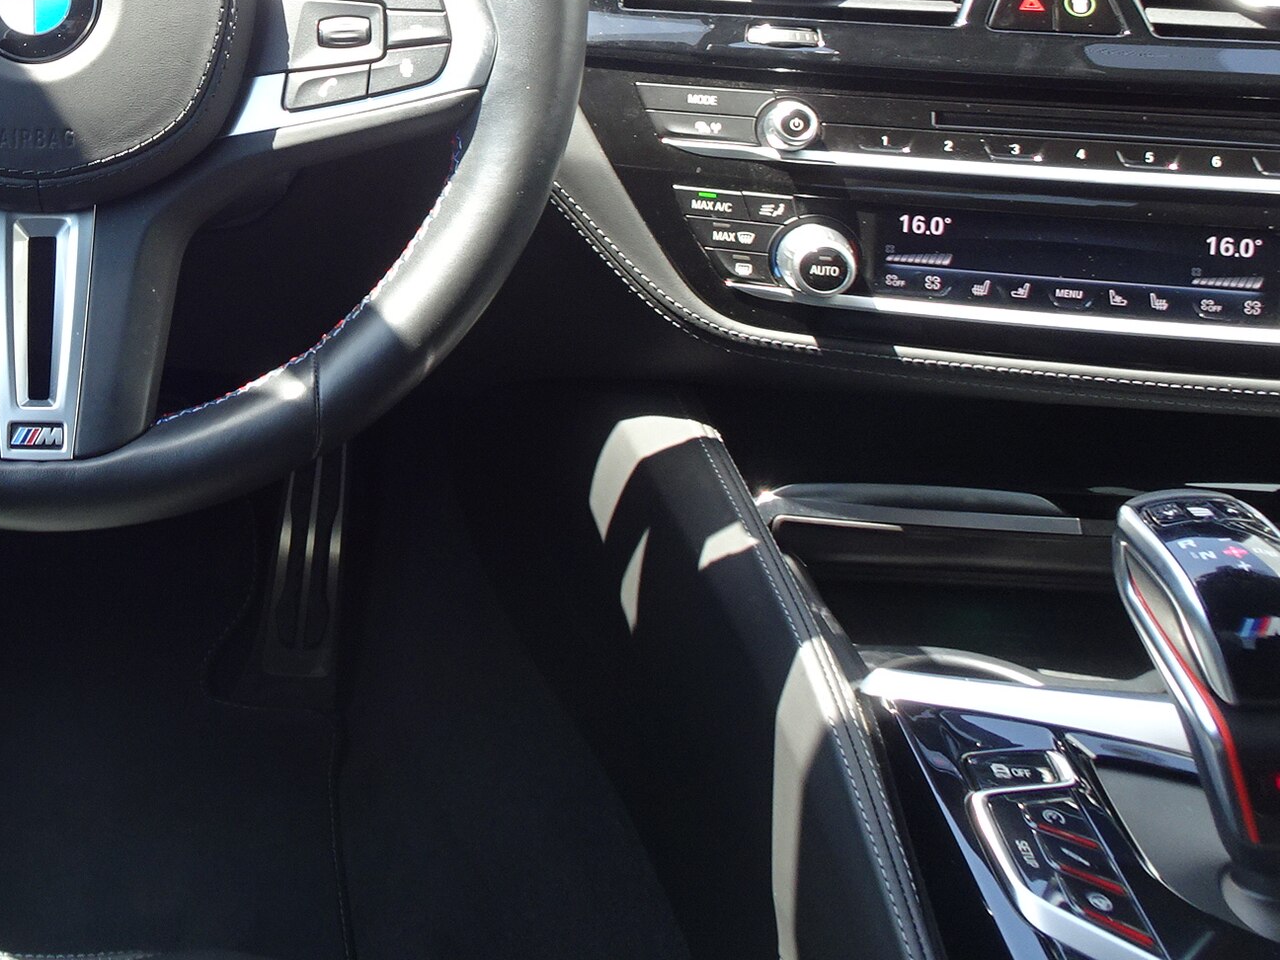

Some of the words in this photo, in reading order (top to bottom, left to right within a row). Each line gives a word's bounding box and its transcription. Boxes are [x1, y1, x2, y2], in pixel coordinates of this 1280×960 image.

[687, 93, 718, 106] MODE
[881, 135, 889, 146] 1
[943, 140, 953, 152] 2
[1010, 143, 1020, 155] 3
[1075, 148, 1086, 160] 4
[1144, 152, 1154, 163] 5
[1211, 156, 1222, 169] 6
[691, 199, 714, 211] MAX
[714, 201, 733, 213] A/C
[898, 214, 953, 236] 16.0°
[712, 230, 736, 243] MAX
[1205, 235, 1264, 259] 16.0°
[809, 264, 840, 278] AUTO
[1055, 288, 1084, 300] MENU
[1010, 767, 1033, 780] OFF
[1014, 839, 1040, 869] SETUP
